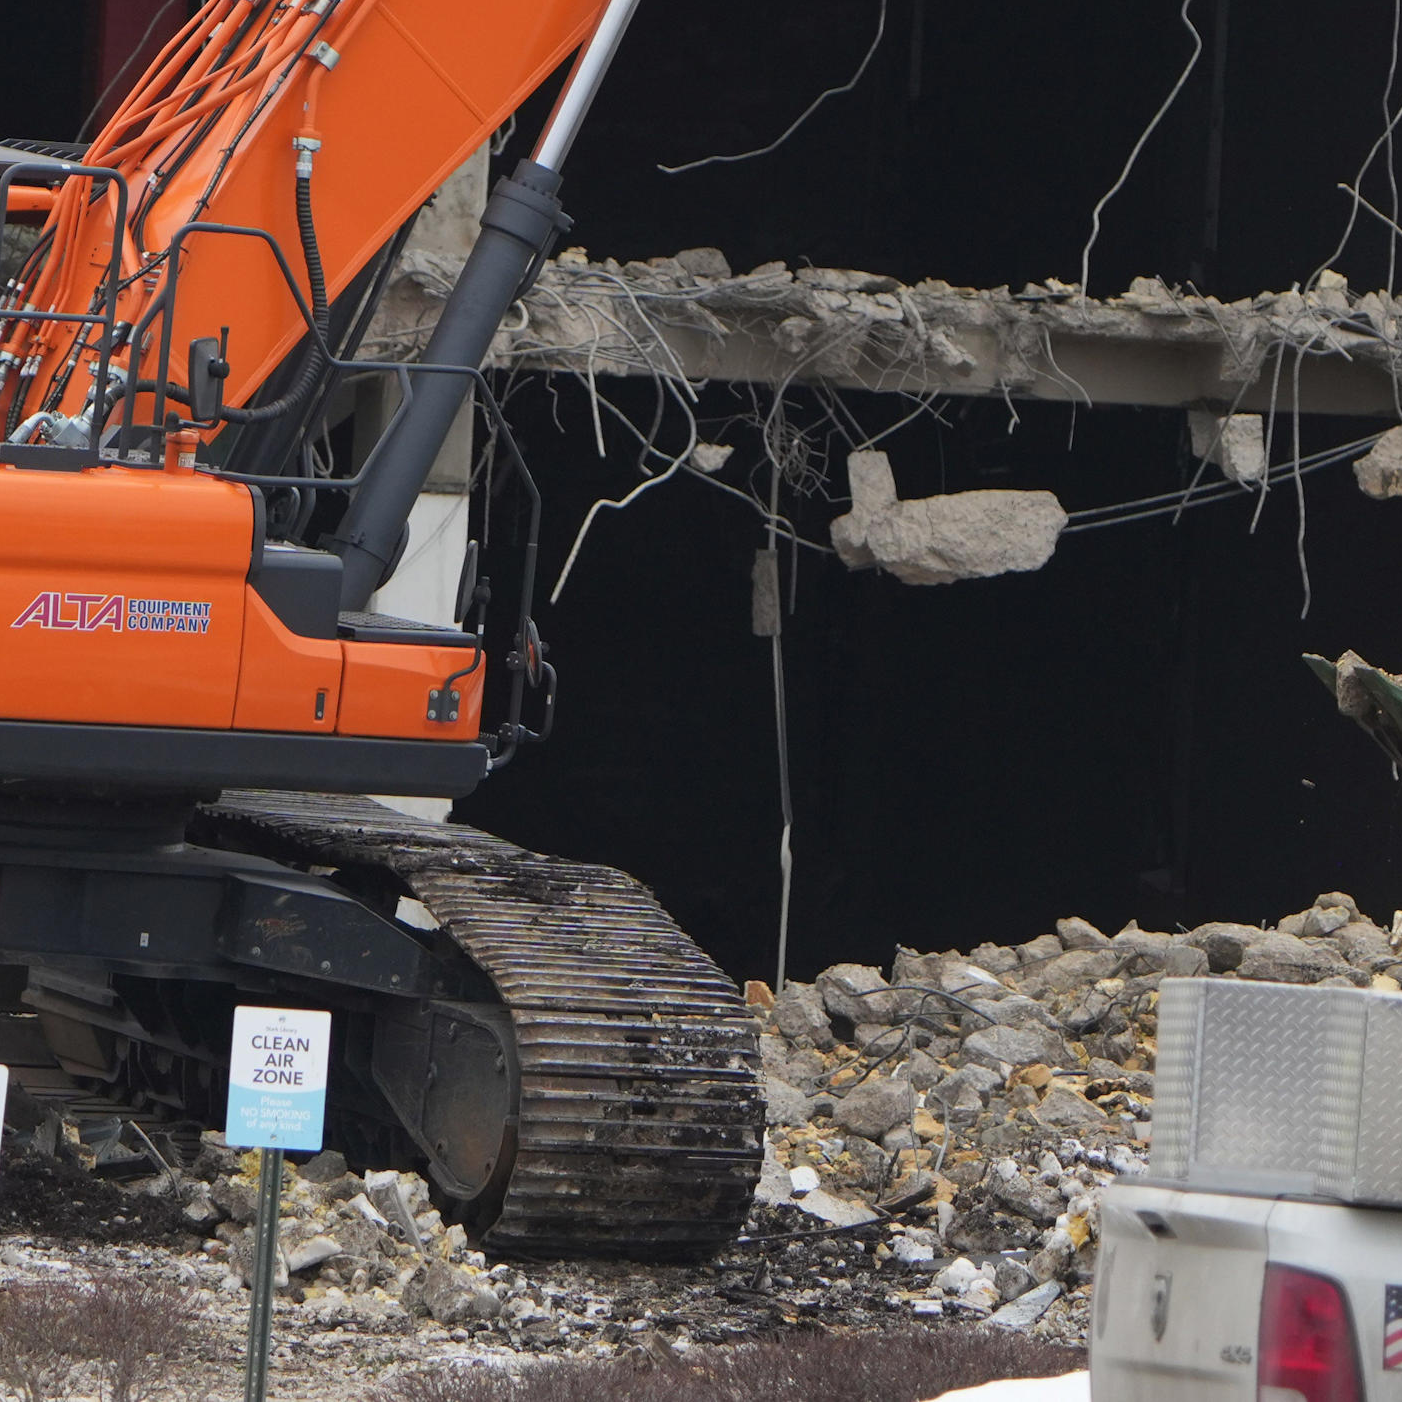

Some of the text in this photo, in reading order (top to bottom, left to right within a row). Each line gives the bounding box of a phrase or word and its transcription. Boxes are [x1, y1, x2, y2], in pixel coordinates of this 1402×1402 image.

[10, 592, 124, 632] ALTA
[128, 599, 212, 617] EQUIPMENT
[127, 614, 211, 634] COMPANY
[251, 1035, 310, 1052] CLEAN
[265, 1053, 294, 1068] AIR
[253, 1069, 304, 1086] ZONE
[261, 1095, 293, 1107] Please
[240, 1107, 311, 1121] NO SMOKING
[246, 1119, 257, 1129] of
[259, 1120, 278, 1132] any
